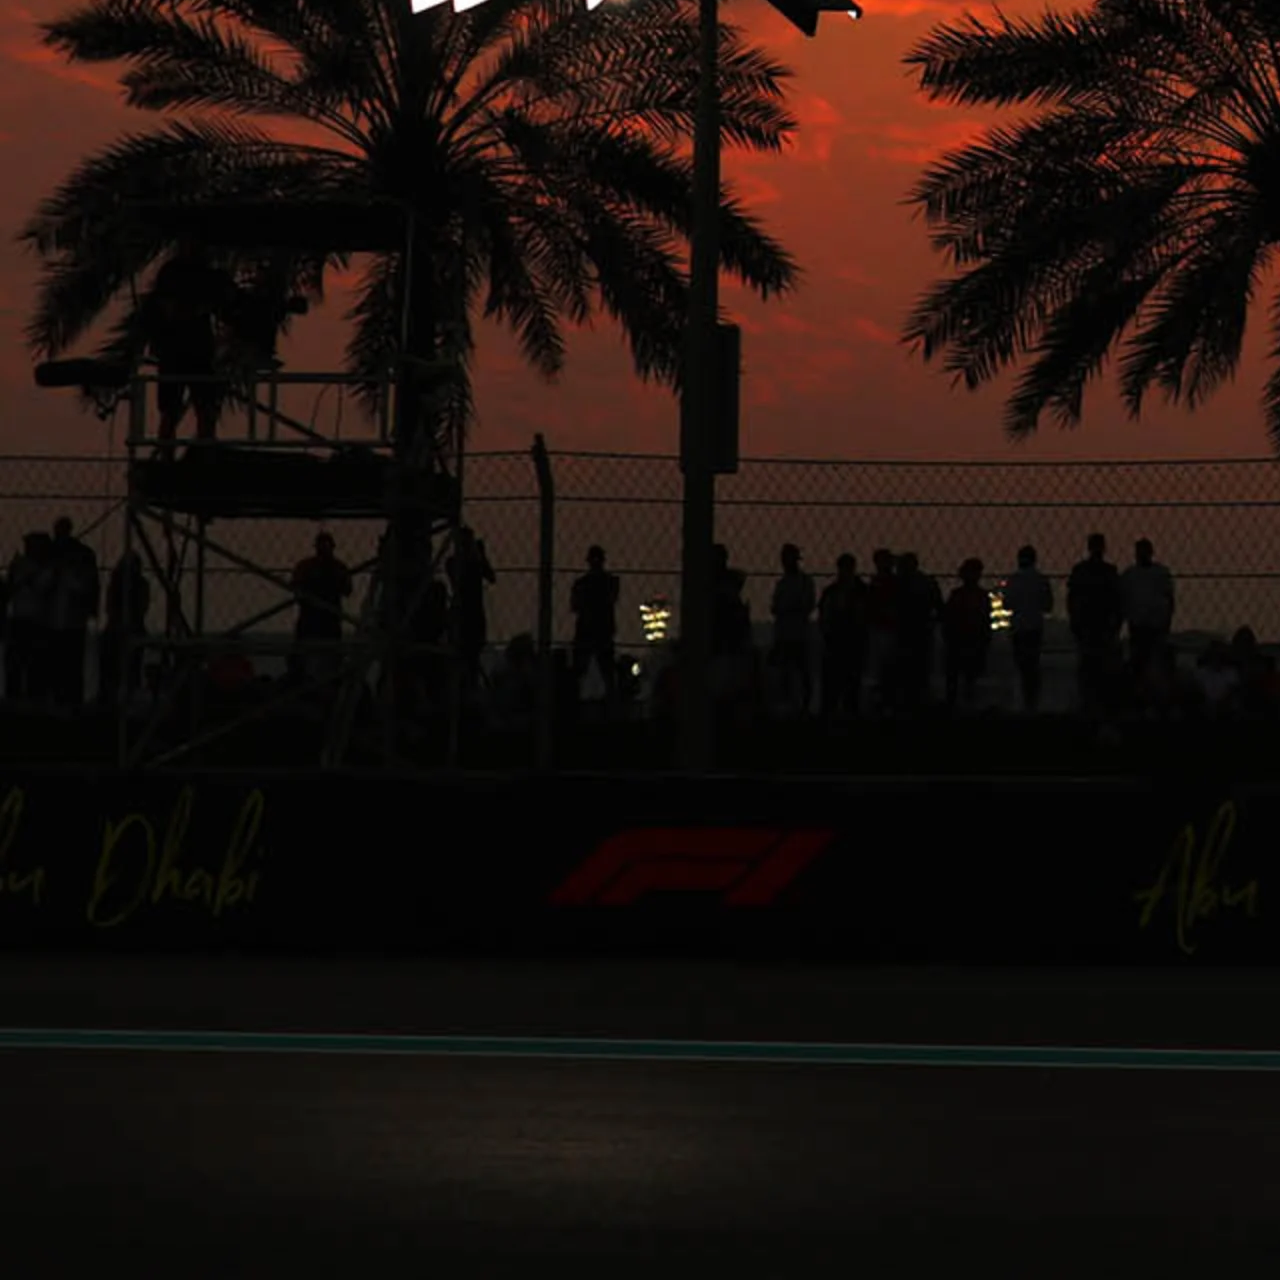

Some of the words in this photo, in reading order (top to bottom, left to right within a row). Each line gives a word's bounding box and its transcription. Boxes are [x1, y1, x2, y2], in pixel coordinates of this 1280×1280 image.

[86, 783, 265, 927] Dhabi
[546, 825, 840, 907] F1
[1131, 800, 1259, 957] Abu
